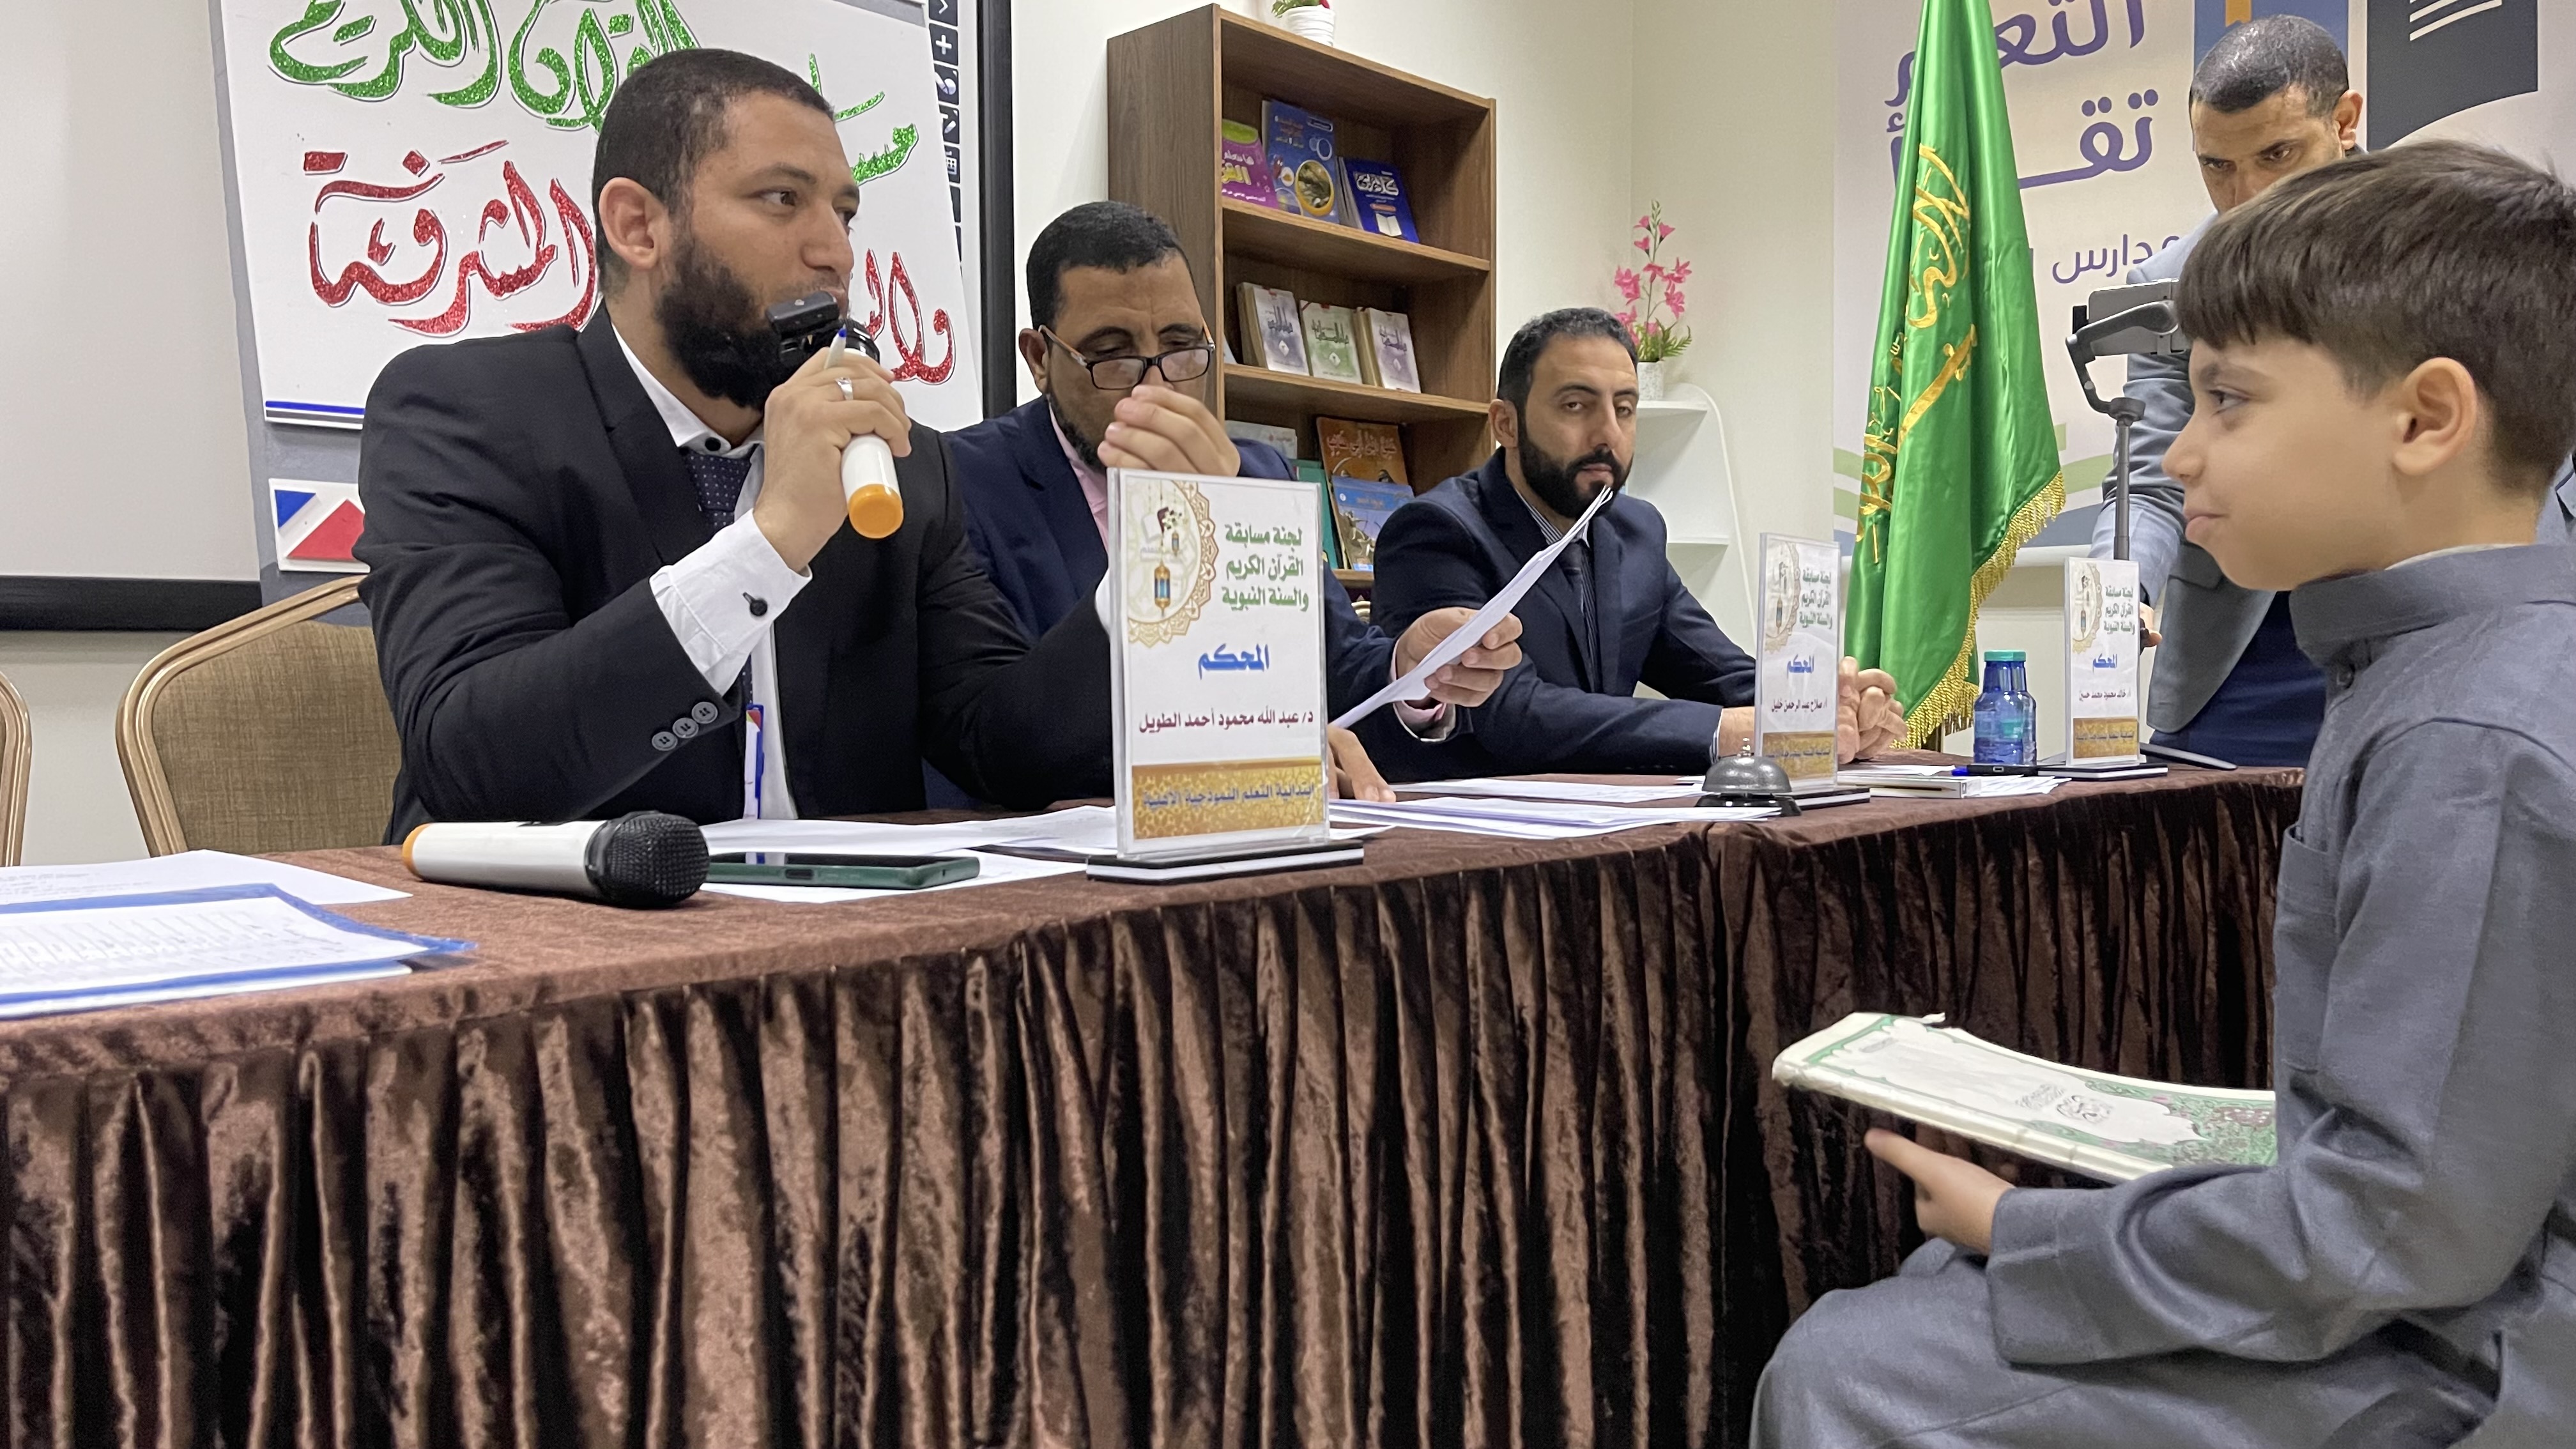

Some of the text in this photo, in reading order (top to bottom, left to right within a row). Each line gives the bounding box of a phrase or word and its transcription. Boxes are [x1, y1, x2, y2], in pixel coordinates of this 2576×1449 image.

[1224, 521, 1303, 553] لجنة مسابقة
[1226, 553, 1304, 582] القرآن الكريم
[1221, 585, 1309, 613] والسنة النبوية
[1198, 643, 1269, 680] المحكم
[1139, 712, 1181, 733] الطويل
[1184, 707, 1215, 727] أحمد
[1218, 713, 1254, 730] محمود
[1257, 705, 1276, 724] الله
[1278, 710, 1300, 728] عبد
